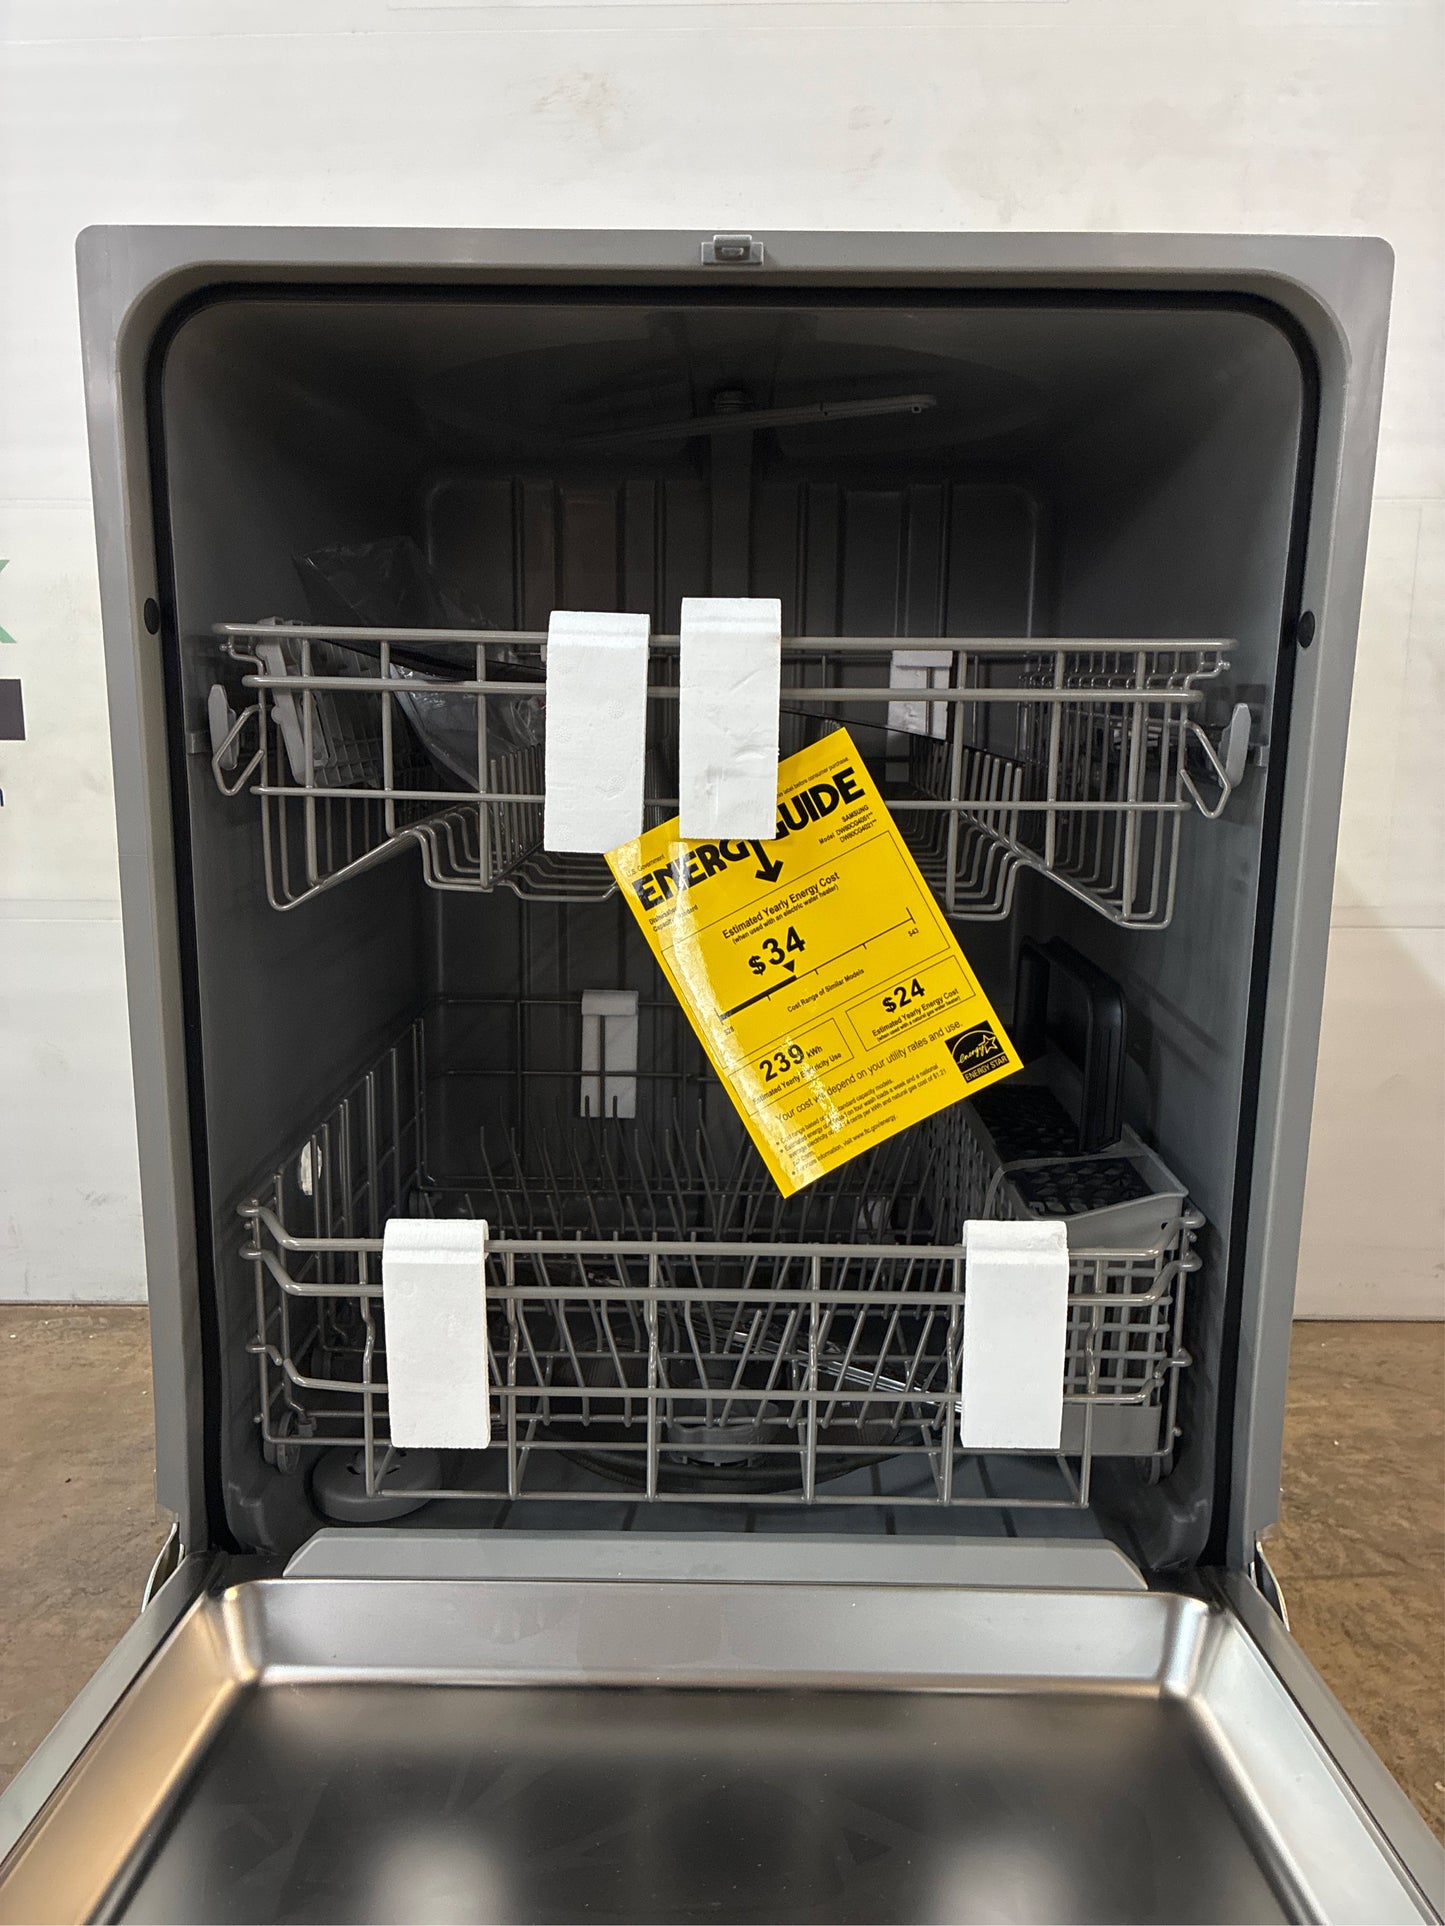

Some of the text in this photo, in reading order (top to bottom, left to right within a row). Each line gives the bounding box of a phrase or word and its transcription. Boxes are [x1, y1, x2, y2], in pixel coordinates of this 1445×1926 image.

[807, 767, 829, 781] consumer
[841, 803, 869, 823] SAMSUNG
[818, 832, 835, 844] Model
[636, 853, 665, 872] Government
[721, 870, 840, 939] Estimated Yearly Energy Cost
[731, 882, 839, 945] (when used with an electric water heater)
[746, 925, 807, 977] $34
[786, 967, 864, 1013] Cost Range of Similar Models
[881, 977, 926, 1014] $24
[871, 986, 959, 1037] Estimated Yearly Energy Cost
[751, 1083, 782, 1105] Estimated
[780, 1073, 802, 1090] Yearly
[828, 1050, 842, 1062] Use
[758, 1043, 823, 1082] 239 kWh
[775, 1106, 796, 1124] Your
[794, 1097, 813, 1113] cost
[825, 1073, 857, 1098] depend
[855, 1068, 867, 1080] on
[867, 1058, 887, 1075] your
[884, 1045, 908, 1066] utility
[906, 1035, 928, 1053] rates
[927, 1026, 944, 1041] and
[943, 1018, 963, 1034] use.
[964, 1054, 1008, 1082] ENERGY STAR
